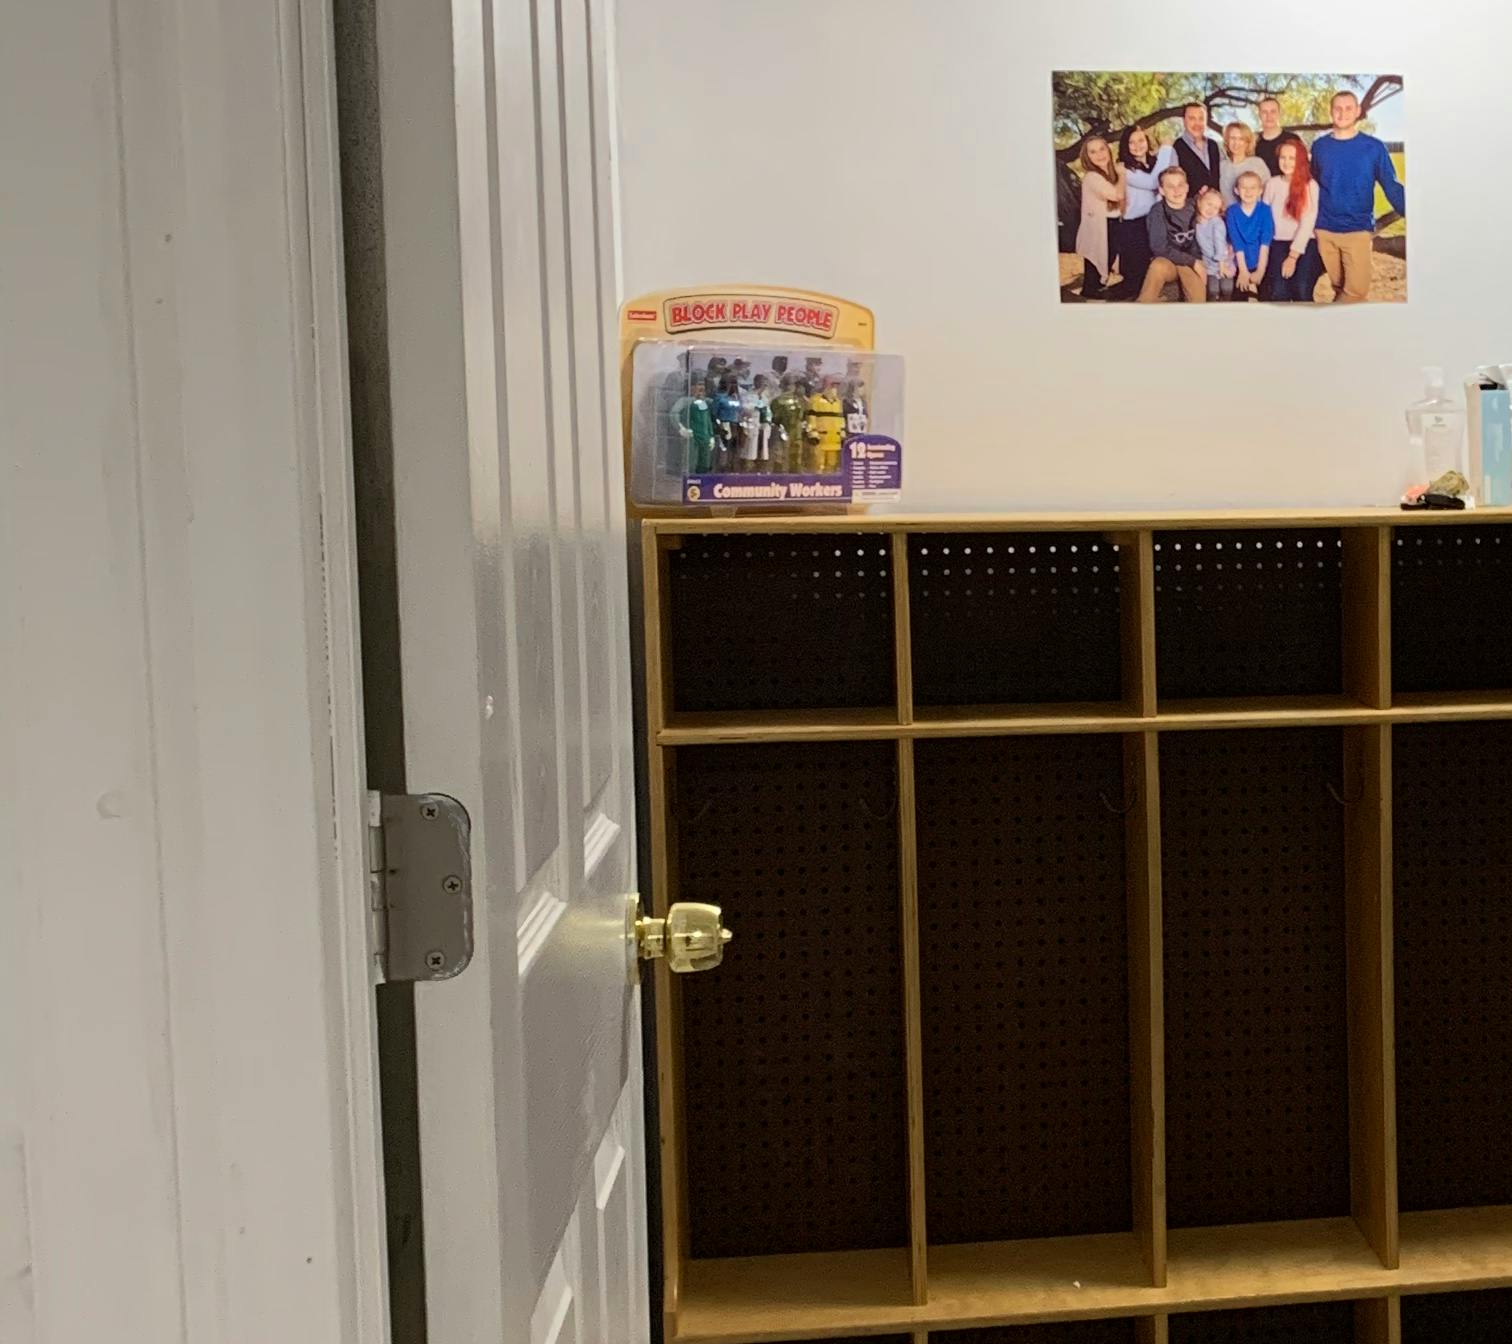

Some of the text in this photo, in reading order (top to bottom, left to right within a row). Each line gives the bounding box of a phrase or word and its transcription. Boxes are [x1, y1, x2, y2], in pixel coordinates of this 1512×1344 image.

[672, 302, 833, 332] BLOCK PLAY PEOPLE
[713, 482, 787, 499] Community
[789, 482, 843, 497] Workers
